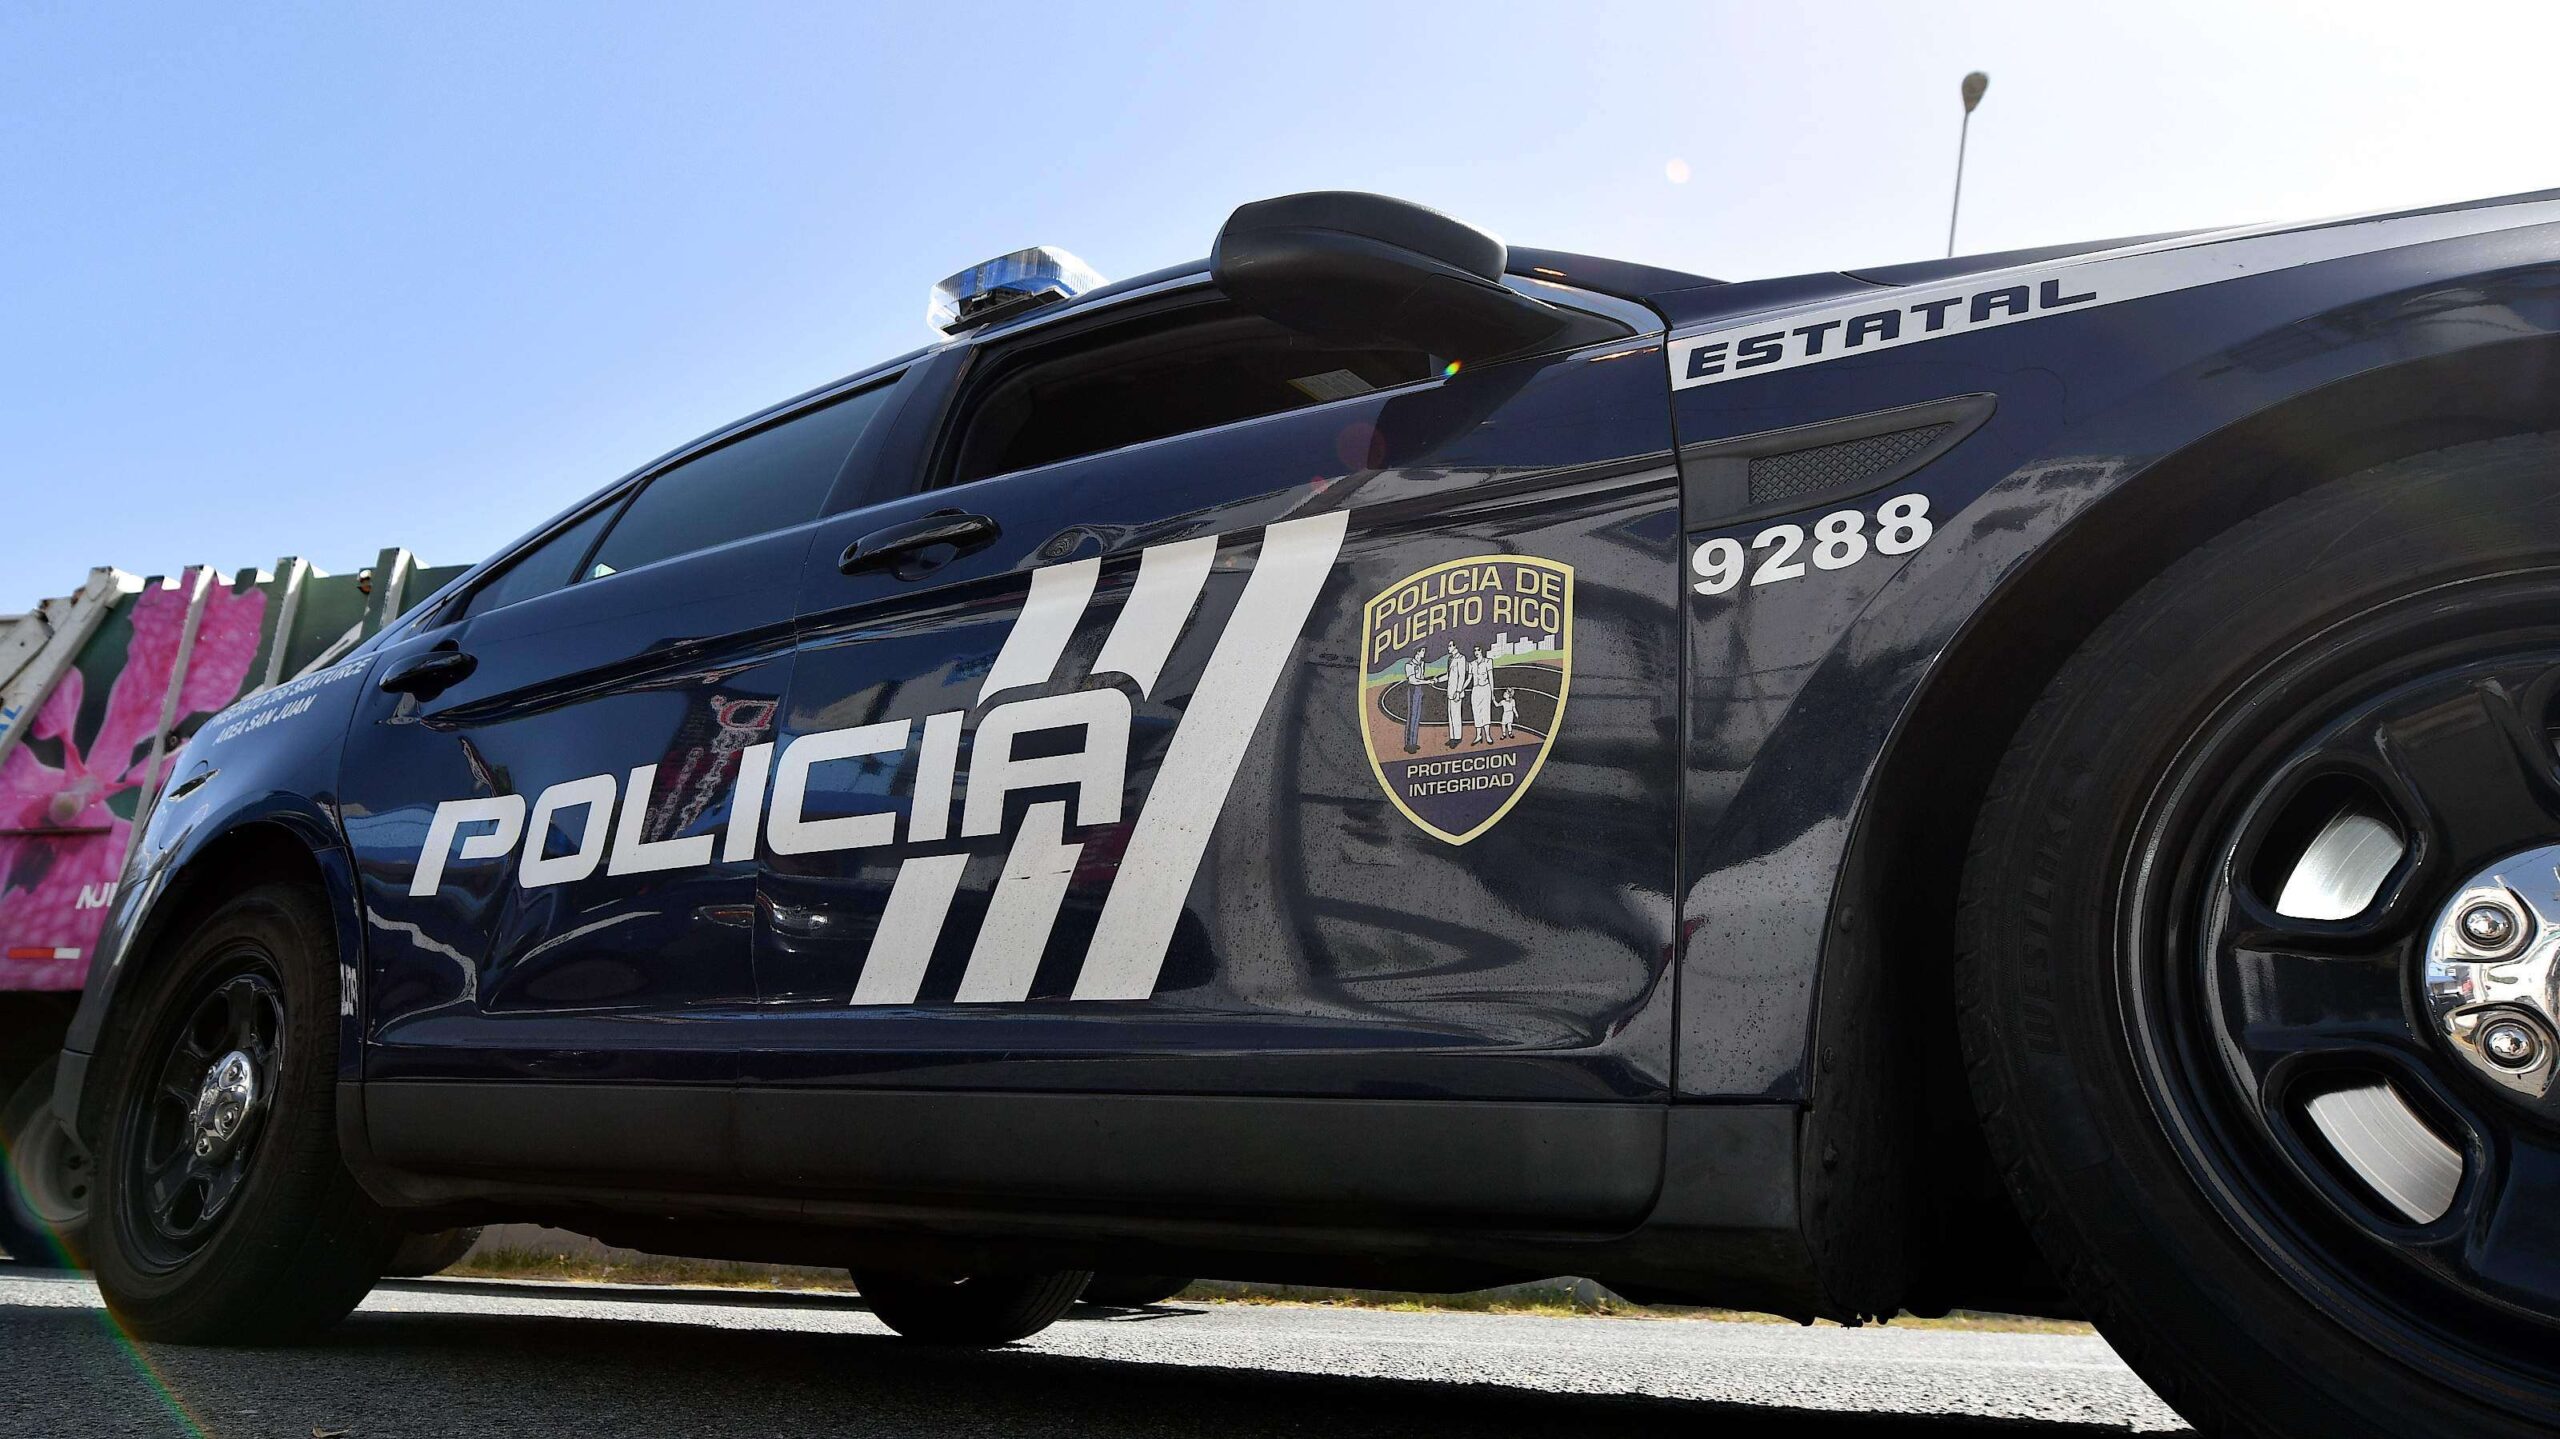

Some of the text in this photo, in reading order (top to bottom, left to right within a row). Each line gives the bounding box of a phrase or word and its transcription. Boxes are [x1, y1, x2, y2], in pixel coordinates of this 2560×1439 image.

[1686, 279, 2097, 380] ESTATAL
[1692, 493, 1933, 595] 9288
[1373, 595, 1560, 664] PUERTO RICO
[1374, 565, 1562, 631] POLICIA DE
[288, 658, 372, 697] SANTURCE
[212, 719, 248, 746] AREA
[245, 706, 278, 732] SAN
[273, 694, 318, 722] JUAN
[409, 686, 1133, 897] POLICIA
[1406, 752, 1517, 778] PROTECCION
[1408, 772, 1515, 797] INTEGRIDAD
[2020, 785, 2080, 1056] WESTLAKE
